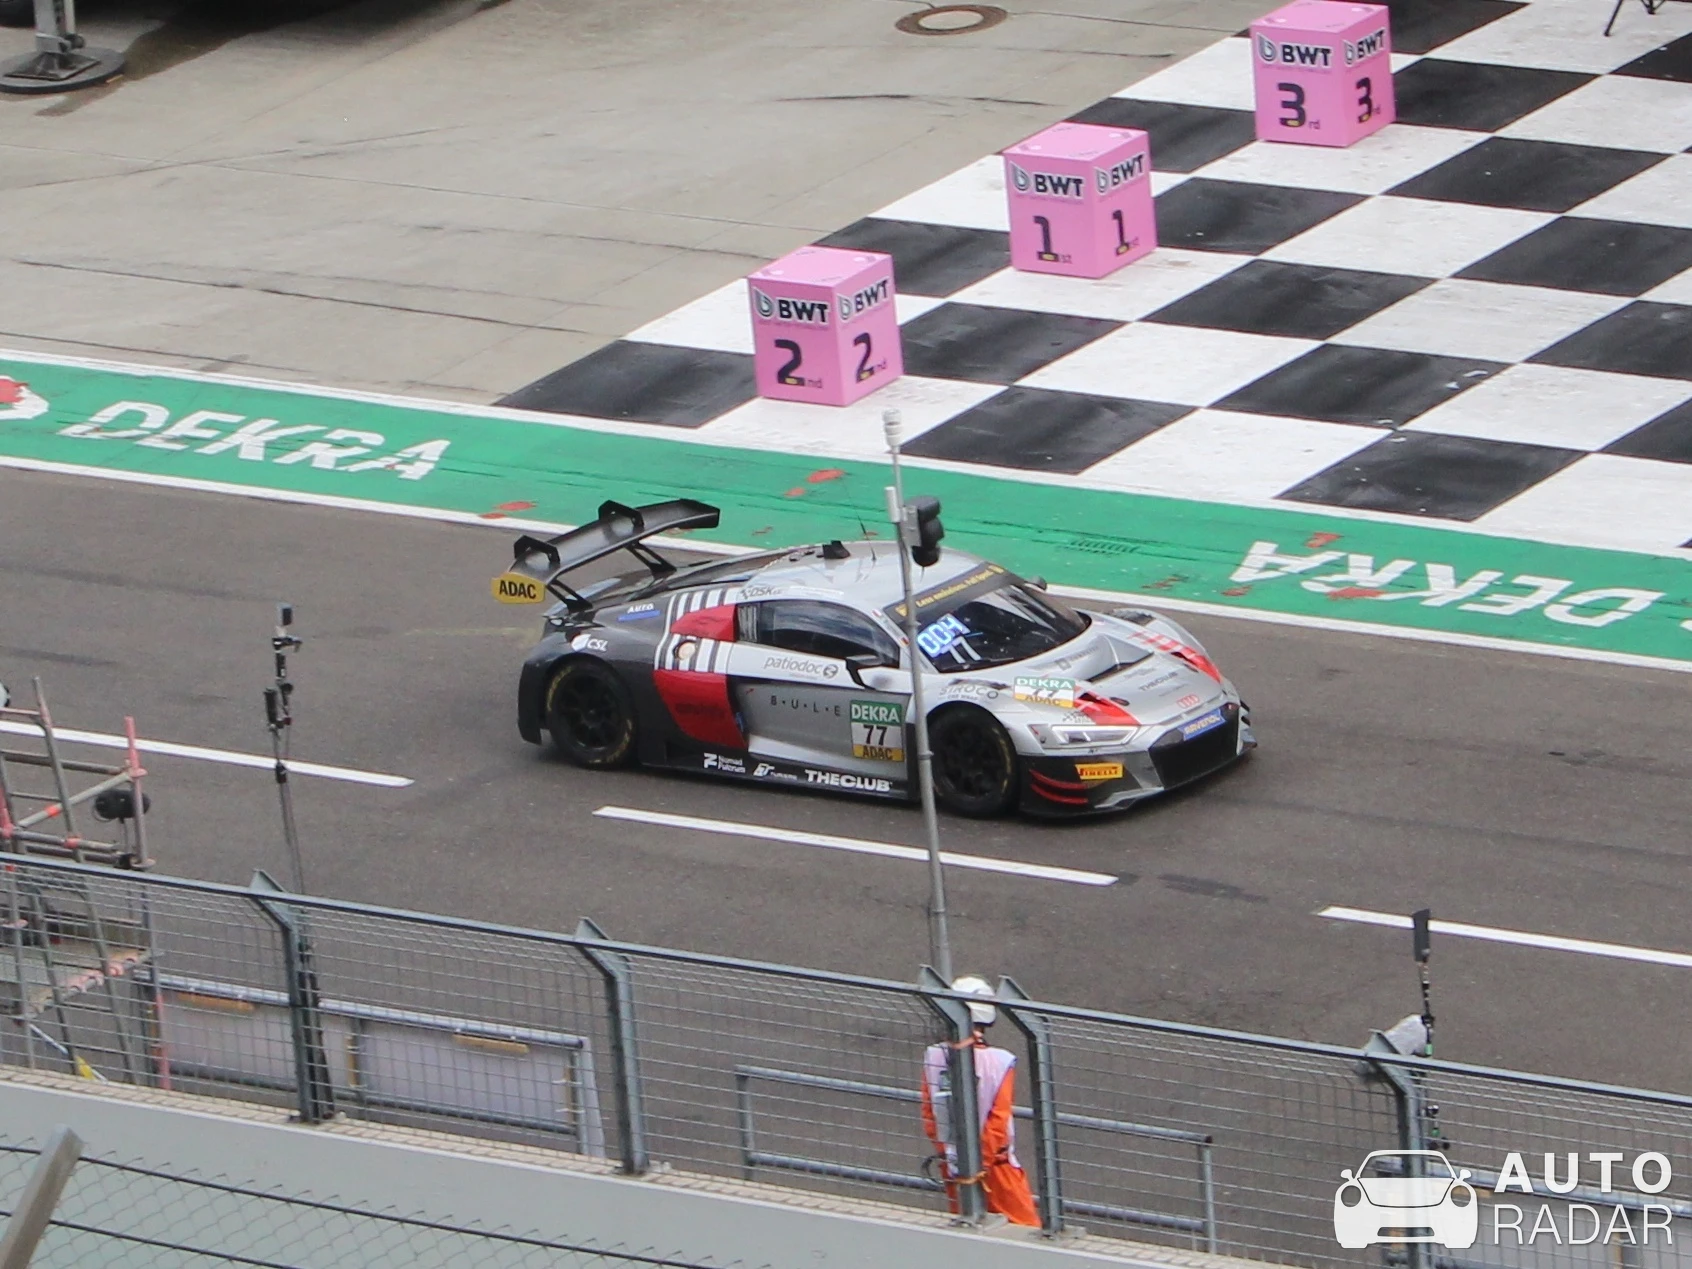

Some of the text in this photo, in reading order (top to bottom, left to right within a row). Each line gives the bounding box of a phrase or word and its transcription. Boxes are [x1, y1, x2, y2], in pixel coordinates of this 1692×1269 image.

[1358, 29, 1385, 58] BWT
[1282, 44, 1331, 66] BWT
[1111, 154, 1144, 186] BWT
[1034, 174, 1084, 197] BWT
[854, 279, 889, 313] BWT
[778, 299, 828, 323] BWT
[55, 400, 450, 480] DEKRA
[499, 580, 536, 599] ADAC
[1229, 541, 1667, 627] DEKRA
[587, 638, 608, 651] CSL
[763, 657, 823, 674] patiodoc
[1016, 678, 1072, 689] DEKRA
[1025, 695, 1061, 706] ADAC
[851, 704, 900, 723] DEKRA
[863, 725, 888, 746] 77
[862, 746, 893, 760] ADAC
[805, 769, 891, 792] THECLUB
[1080, 766, 1119, 776] PIRELLI
